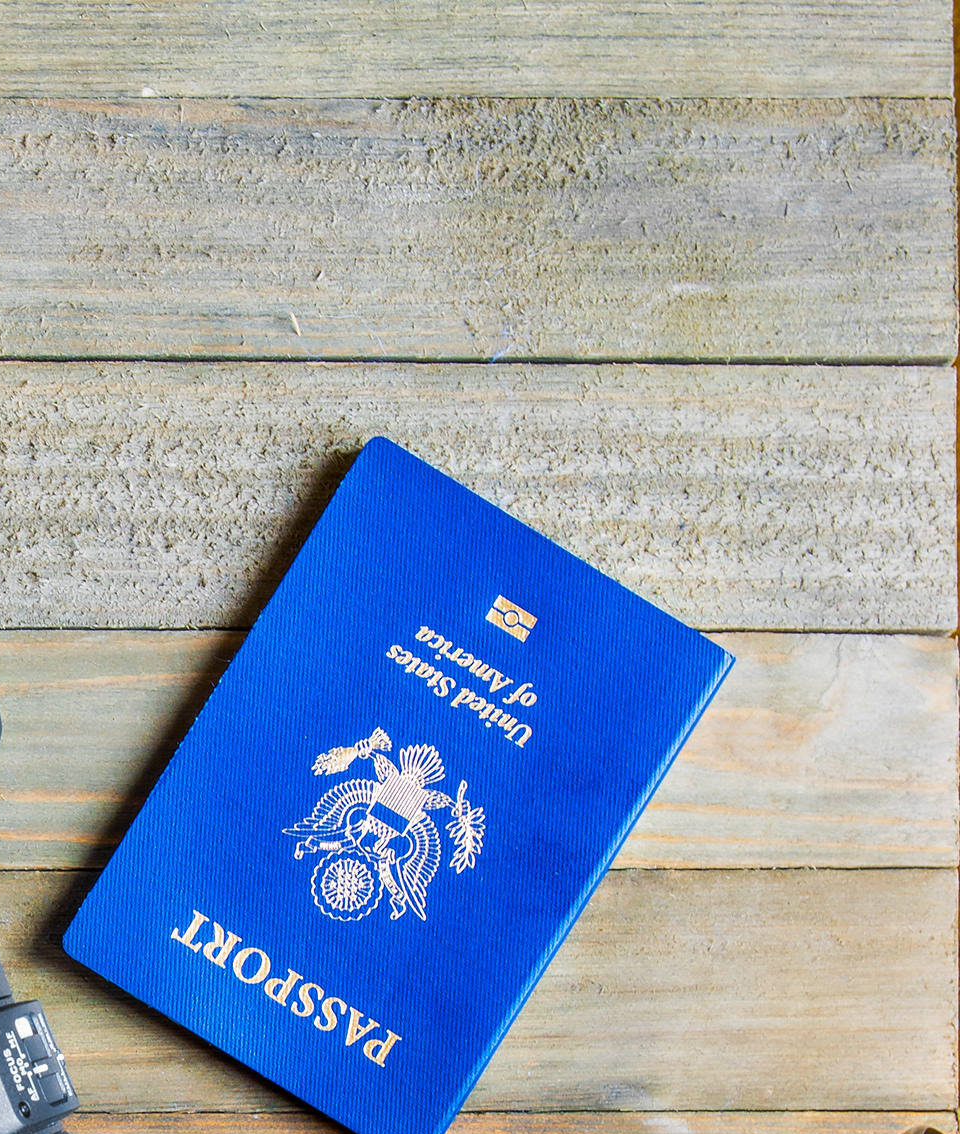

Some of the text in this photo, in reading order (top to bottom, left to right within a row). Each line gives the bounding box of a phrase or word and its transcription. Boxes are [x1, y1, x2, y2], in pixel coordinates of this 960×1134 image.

[385, 643, 534, 749] United States
[415, 624, 538, 708] of America
[171, 909, 403, 1068] PASSPORT
[3, 1048, 25, 1092] FOCUS
